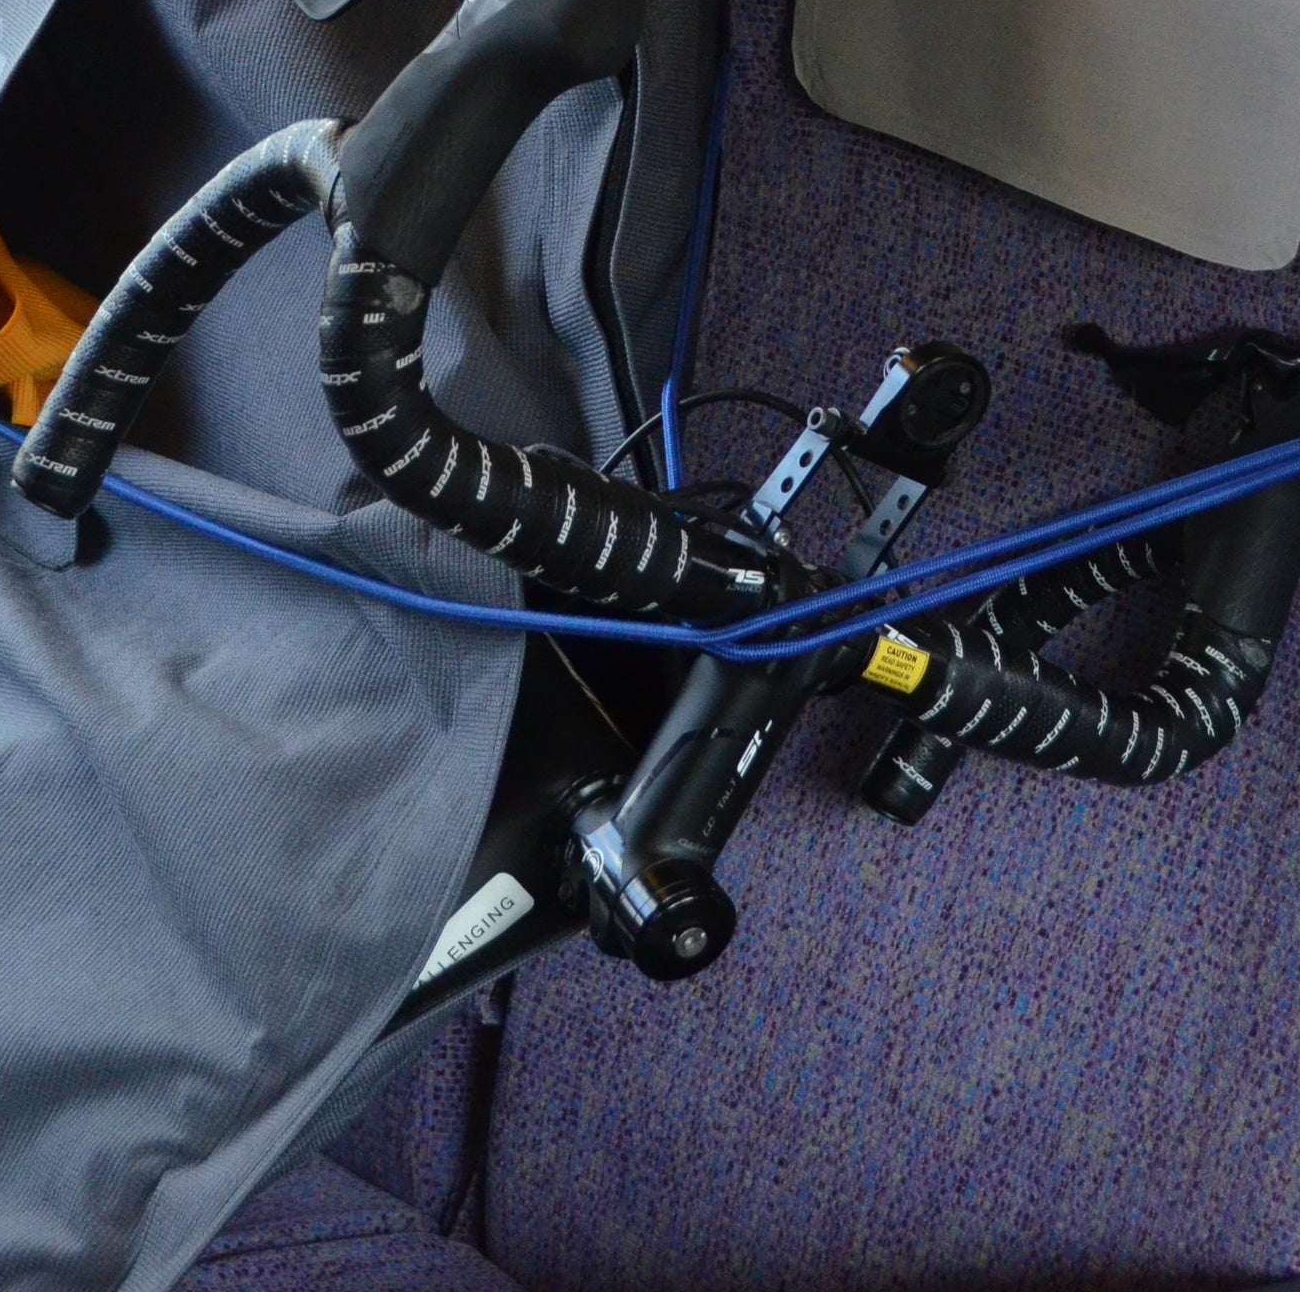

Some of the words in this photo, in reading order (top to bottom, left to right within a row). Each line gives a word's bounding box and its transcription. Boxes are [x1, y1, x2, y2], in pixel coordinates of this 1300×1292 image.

[200, 207, 244, 249] xtrem
[161, 228, 198, 268] xtrem
[129, 264, 154, 293] trem
[136, 330, 184, 344] xtr
[94, 365, 150, 385] xtrem
[395, 344, 423, 369] rem
[322, 371, 361, 386] xtr
[59, 407, 116, 432] xtrem
[343, 405, 398, 436] xtrem
[27, 452, 78, 477] xtrem
[383, 427, 431, 477] xtrem
[429, 435, 460, 498] xtrem
[475, 439, 492, 502] xtrem
[556, 483, 577, 545] xtrem
[595, 510, 619, 571] xtrem
[636, 511, 658, 572] xtrem
[728, 567, 766, 585] SL
[1088, 560, 1119, 593] xtre
[886, 646, 918, 663] CAUTION
[982, 629, 1002, 672] xtre
[918, 683, 954, 721] xtrem
[957, 698, 992, 737] xtrem
[1185, 687, 1216, 738] xtrem
[1226, 696, 1242, 732] trem
[988, 706, 1028, 746] xtrem
[1034, 708, 1071, 754] xtrem
[1121, 710, 1140, 765] xtrem
[1055, 755, 1080, 771] rem
[1141, 727, 1164, 780] xtrem
[1172, 749, 1189, 778] rem
[892, 755, 934, 792] xtrem
[703, 776, 737, 837] COTACT
